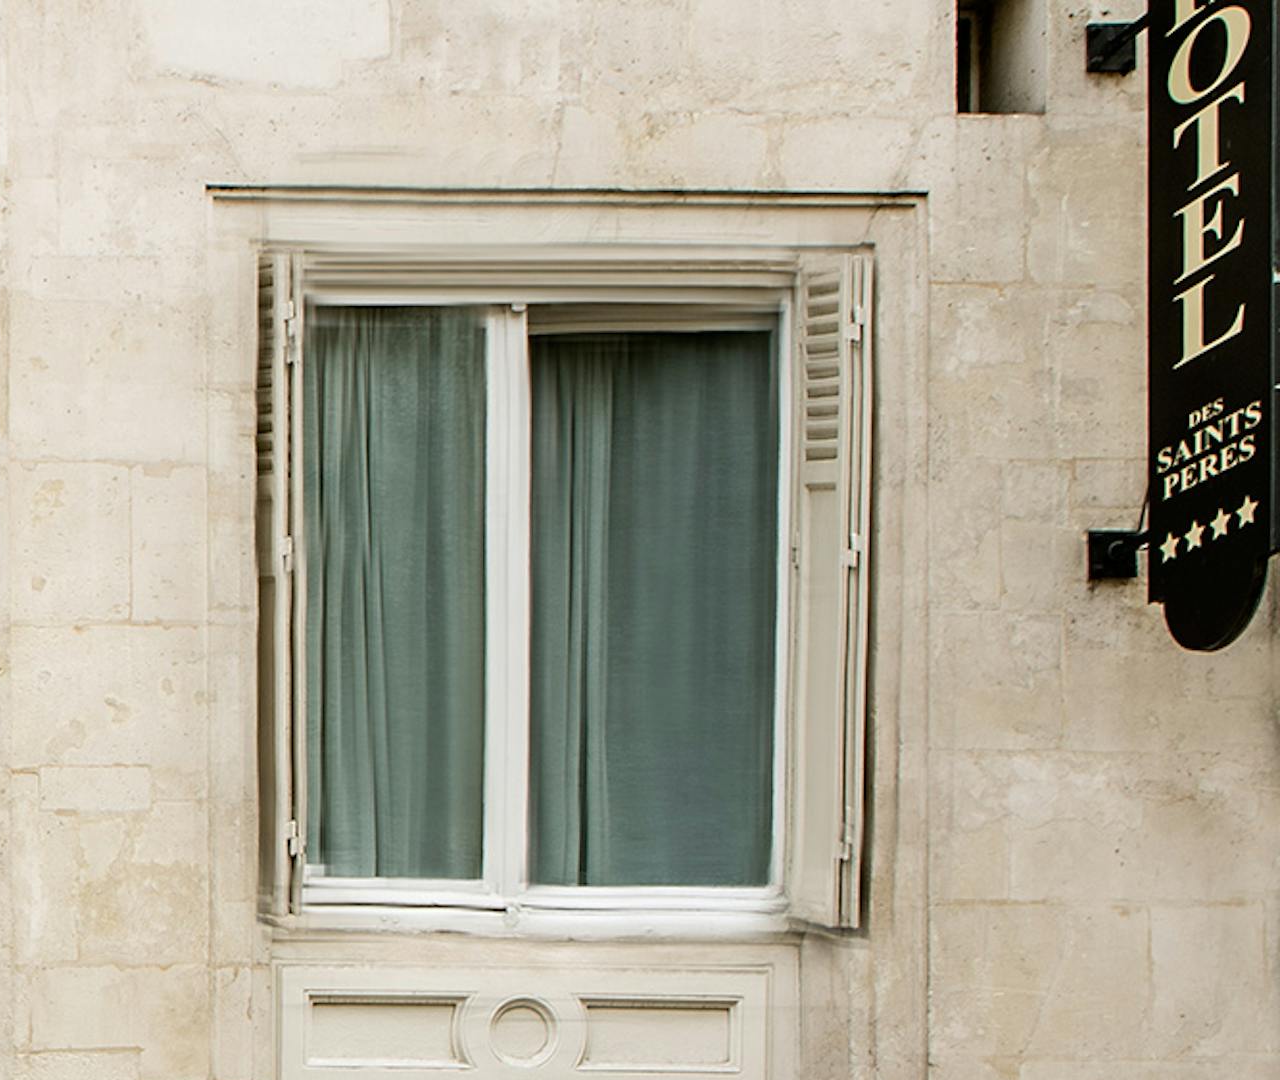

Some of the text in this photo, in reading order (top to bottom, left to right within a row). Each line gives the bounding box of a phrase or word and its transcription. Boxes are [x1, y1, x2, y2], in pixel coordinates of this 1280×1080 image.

[1165, 0, 1251, 370] OTEL
[1157, 400, 1262, 474] SAINTS
[1187, 398, 1224, 429] DES
[1163, 434, 1256, 500] PERES
